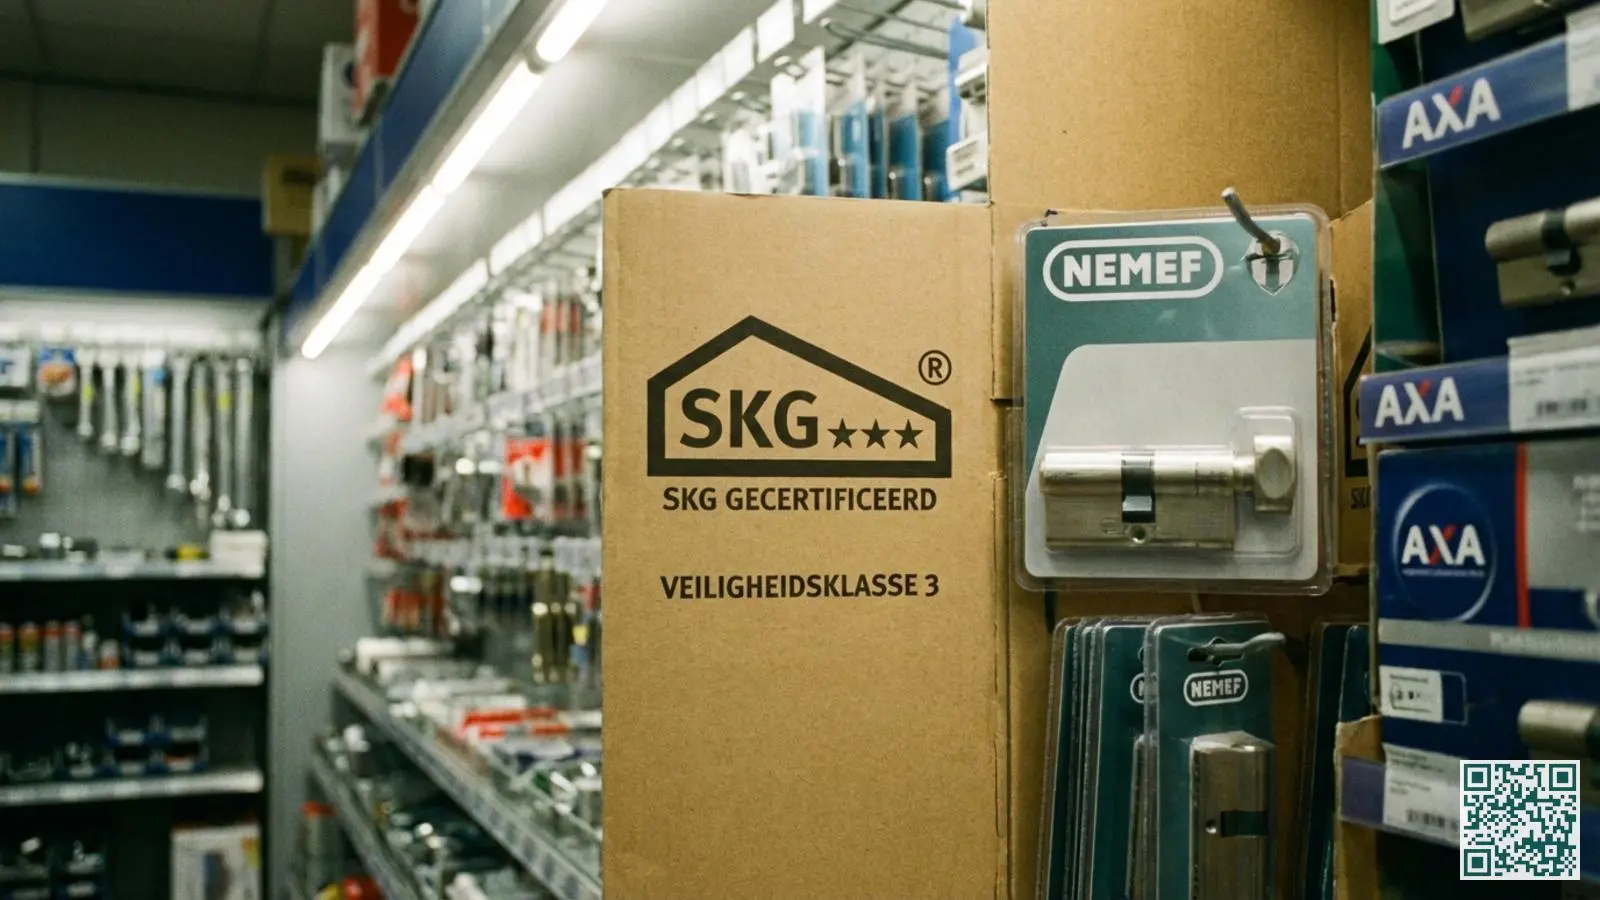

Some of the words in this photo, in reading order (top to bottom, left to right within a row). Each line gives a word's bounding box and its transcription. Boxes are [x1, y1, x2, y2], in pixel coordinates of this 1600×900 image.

[1402, 77, 1501, 149] AXA
[1063, 250, 1201, 288] NEMEF
[680, 388, 818, 448] SKG
[1374, 377, 1464, 428] AXA
[663, 488, 717, 510] SKG
[726, 488, 937, 511] GECERTIFICEERD
[1401, 524, 1486, 566] AXA
[660, 574, 917, 599] VEILIGHEIDSKLASSE
[925, 574, 939, 598] 3
[1191, 678, 1241, 699] NEMEF
